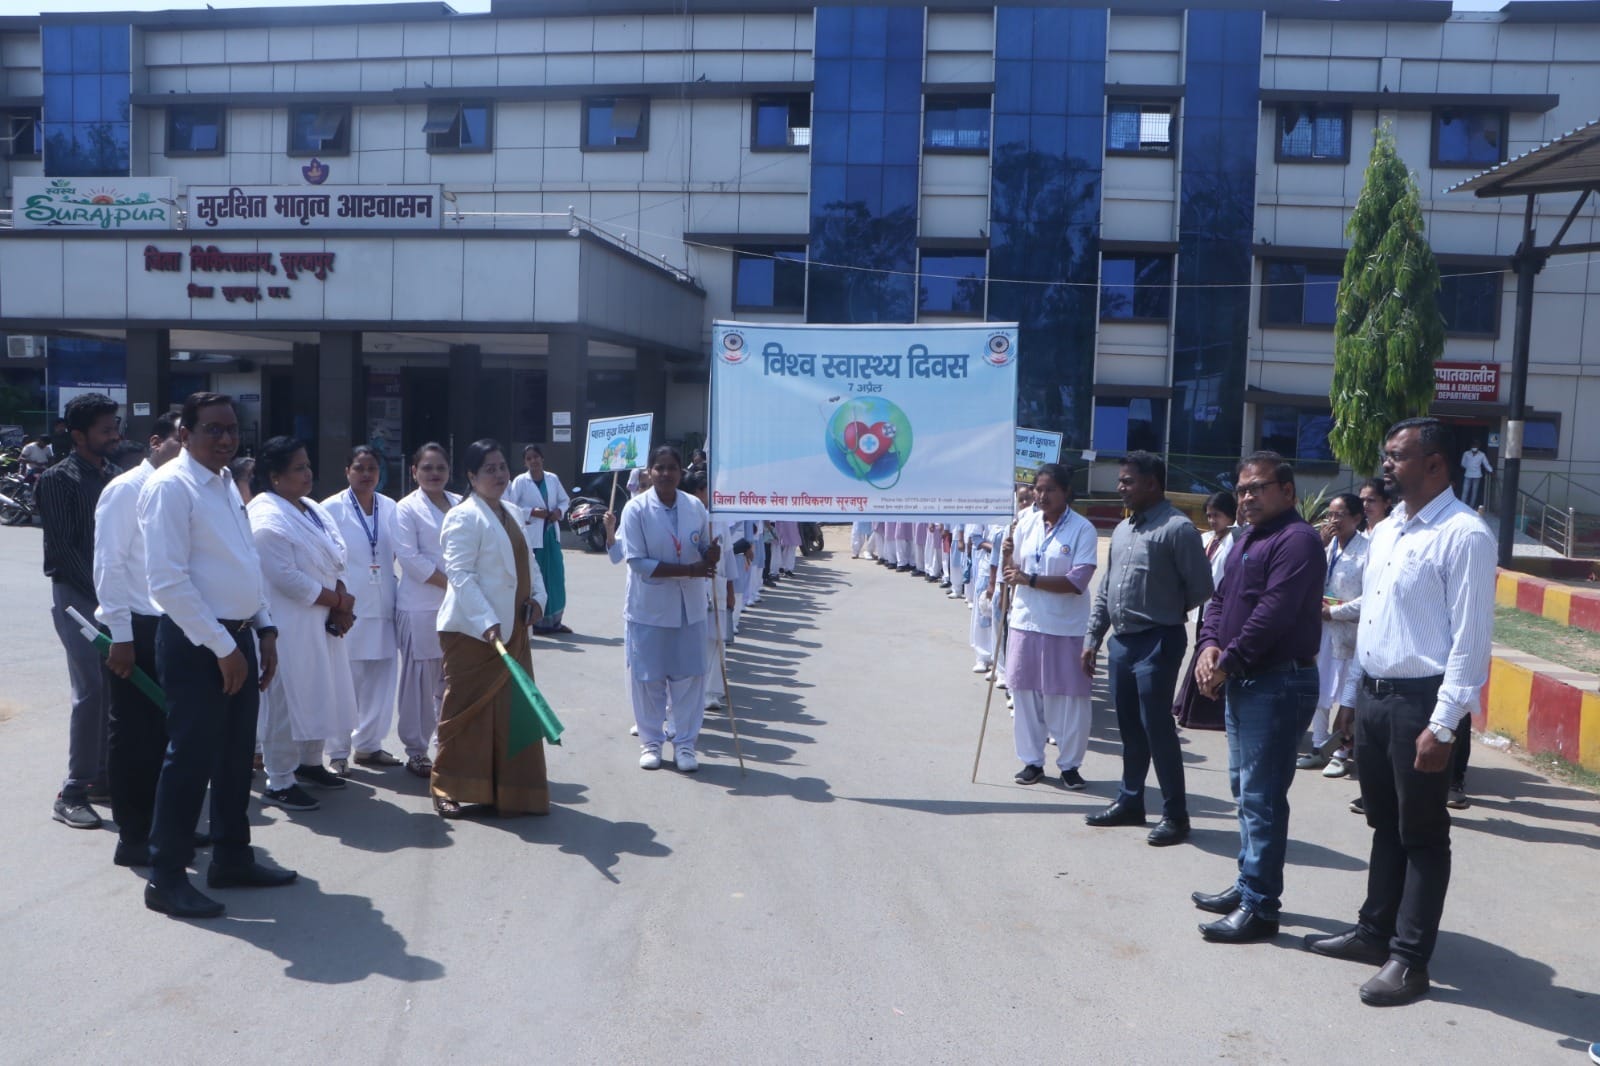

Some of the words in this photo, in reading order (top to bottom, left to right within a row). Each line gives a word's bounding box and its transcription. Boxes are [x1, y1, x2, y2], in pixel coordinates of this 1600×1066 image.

[196, 188, 267, 227] सुरक्षित
[273, 194, 331, 226] मातृत्व
[337, 194, 433, 219] आश्वासन
[143, 245, 182, 272] जिला
[280, 252, 335, 280] सूरजपुर
[762, 342, 815, 377] विश्व
[821, 354, 902, 379] स्वास्थ्य
[907, 344, 969, 379] दिवस
[847, 383, 855, 392] 7
[857, 382, 883, 393] अप्रैल
[1438, 392, 1480, 400] DEPARTMENT
[1457, 384, 1495, 392] EMERGENCY
[712, 491, 735, 505] जिला
[739, 491, 767, 506] विधिक
[770, 491, 788, 506] सेवा
[791, 492, 833, 507] प्राधिकरण
[836, 495, 868, 511] सूरजपुर
